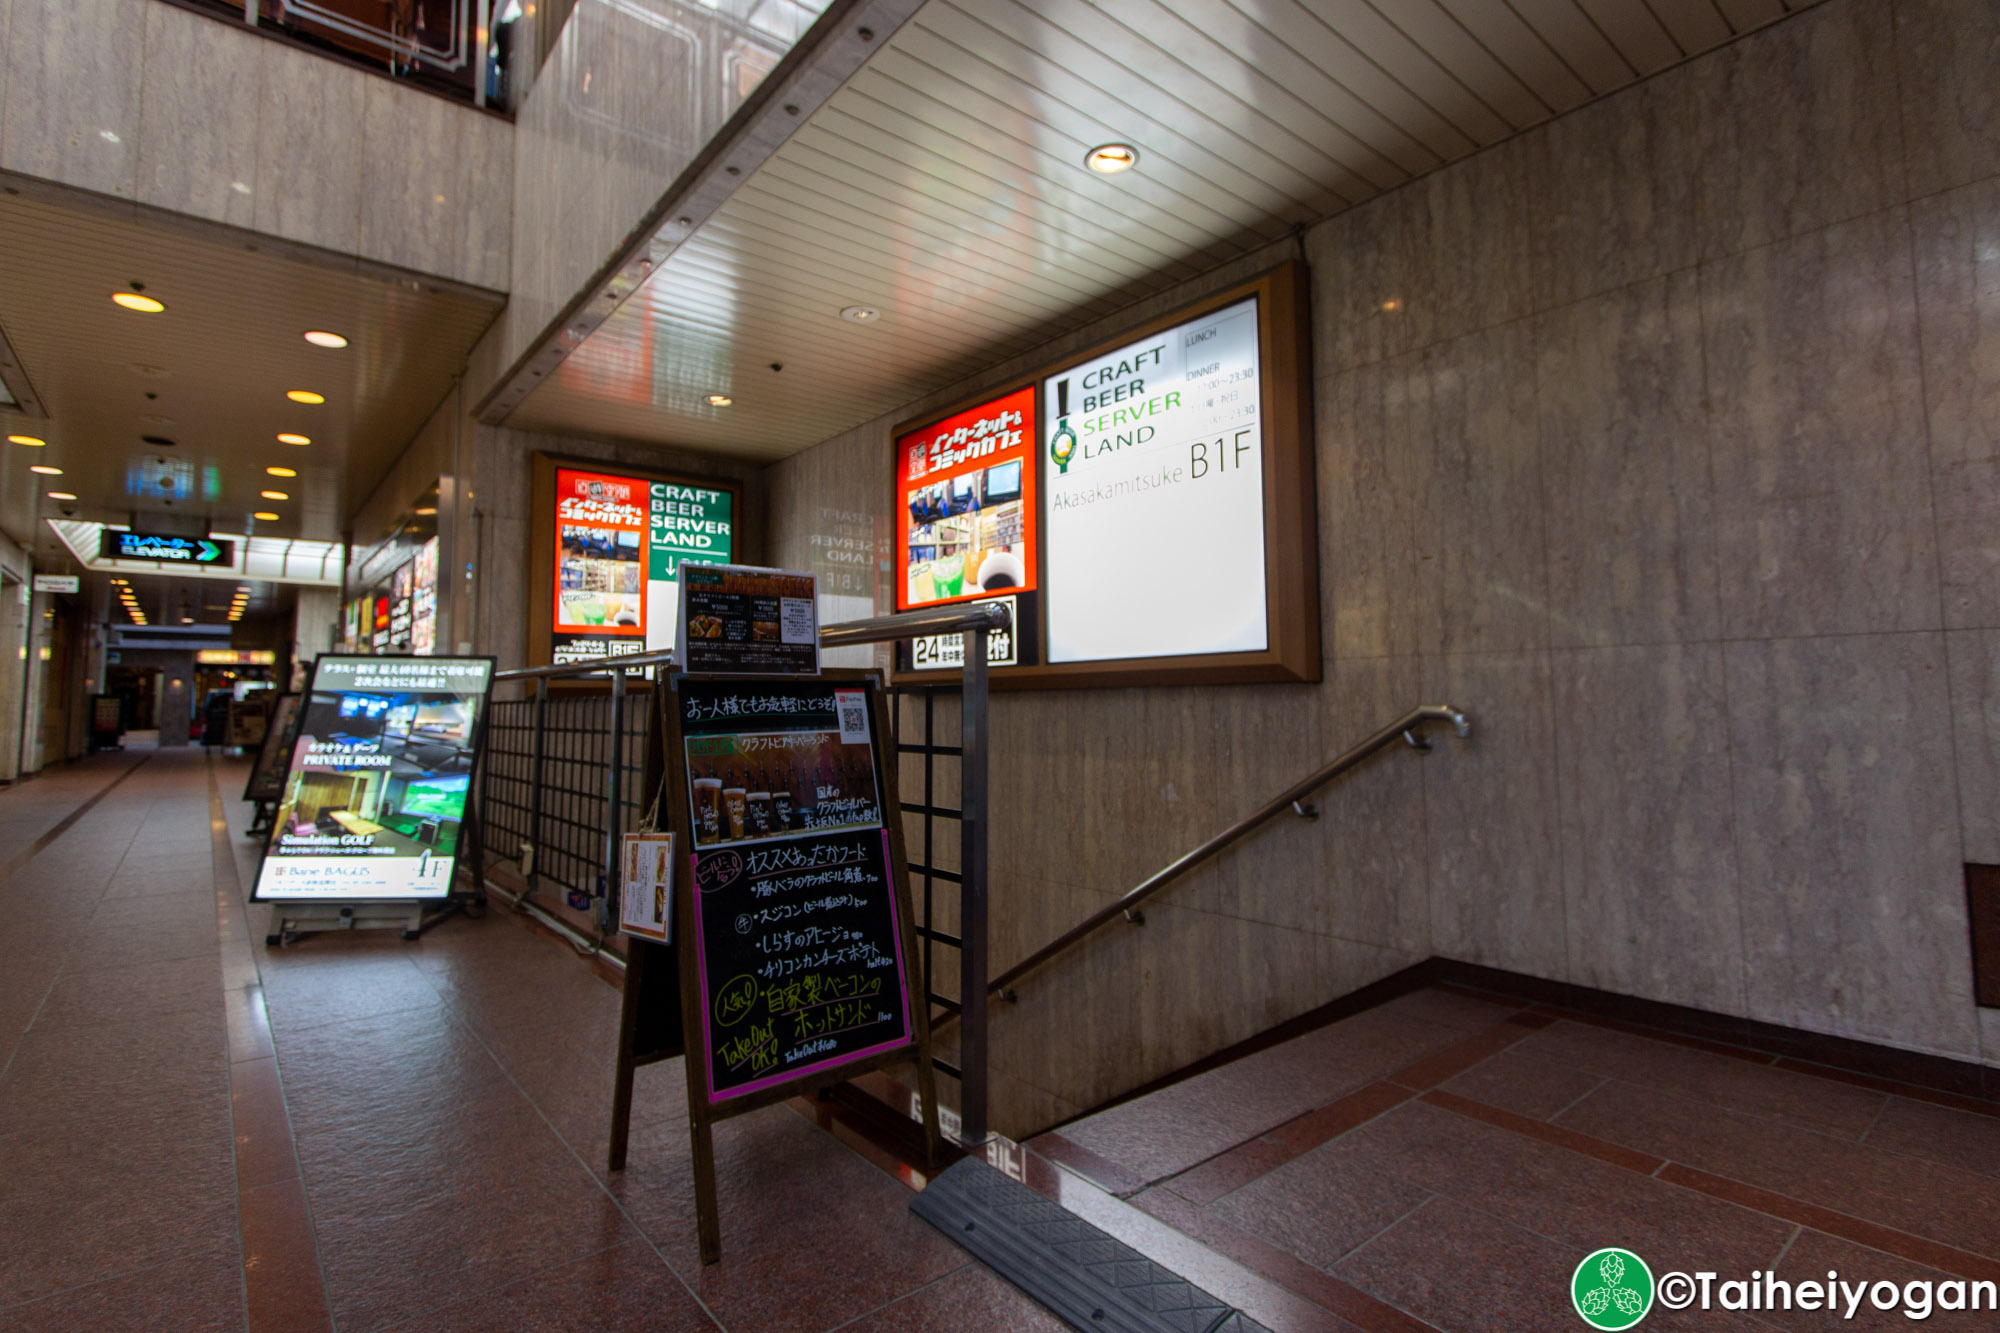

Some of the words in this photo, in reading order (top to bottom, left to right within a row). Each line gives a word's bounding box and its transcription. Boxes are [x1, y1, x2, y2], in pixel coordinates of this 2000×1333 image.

[1186, 328, 1217, 347] LUNCH
[1082, 345, 1166, 389] CRAFT
[1187, 362, 1220, 382] DINNER
[1083, 379, 1145, 413] BEER
[1083, 392, 1181, 437] SERVER
[930, 430, 1023, 473] コミックカフェ
[1084, 426, 1154, 459] LAND
[1053, 465, 1183, 512] Akasakamitsuke
[1191, 430, 1251, 479] B1F
[650, 484, 720, 504] CRAFT
[651, 499, 704, 518] BEER
[650, 514, 730, 535] SERVER
[120, 534, 194, 549] エレベーター
[651, 529, 712, 548] LAND
[122, 546, 190, 559] ELEVATOR
[917, 638, 938, 664] 24
[303, 754, 353, 766] PRIVATE
[354, 754, 392, 767] ROOM
[281, 834, 340, 846] Simulation
[341, 834, 375, 846] GOLF
[765, 972, 882, 1014] 自家製ベーコンの
[794, 999, 872, 1038] ホットサンド
